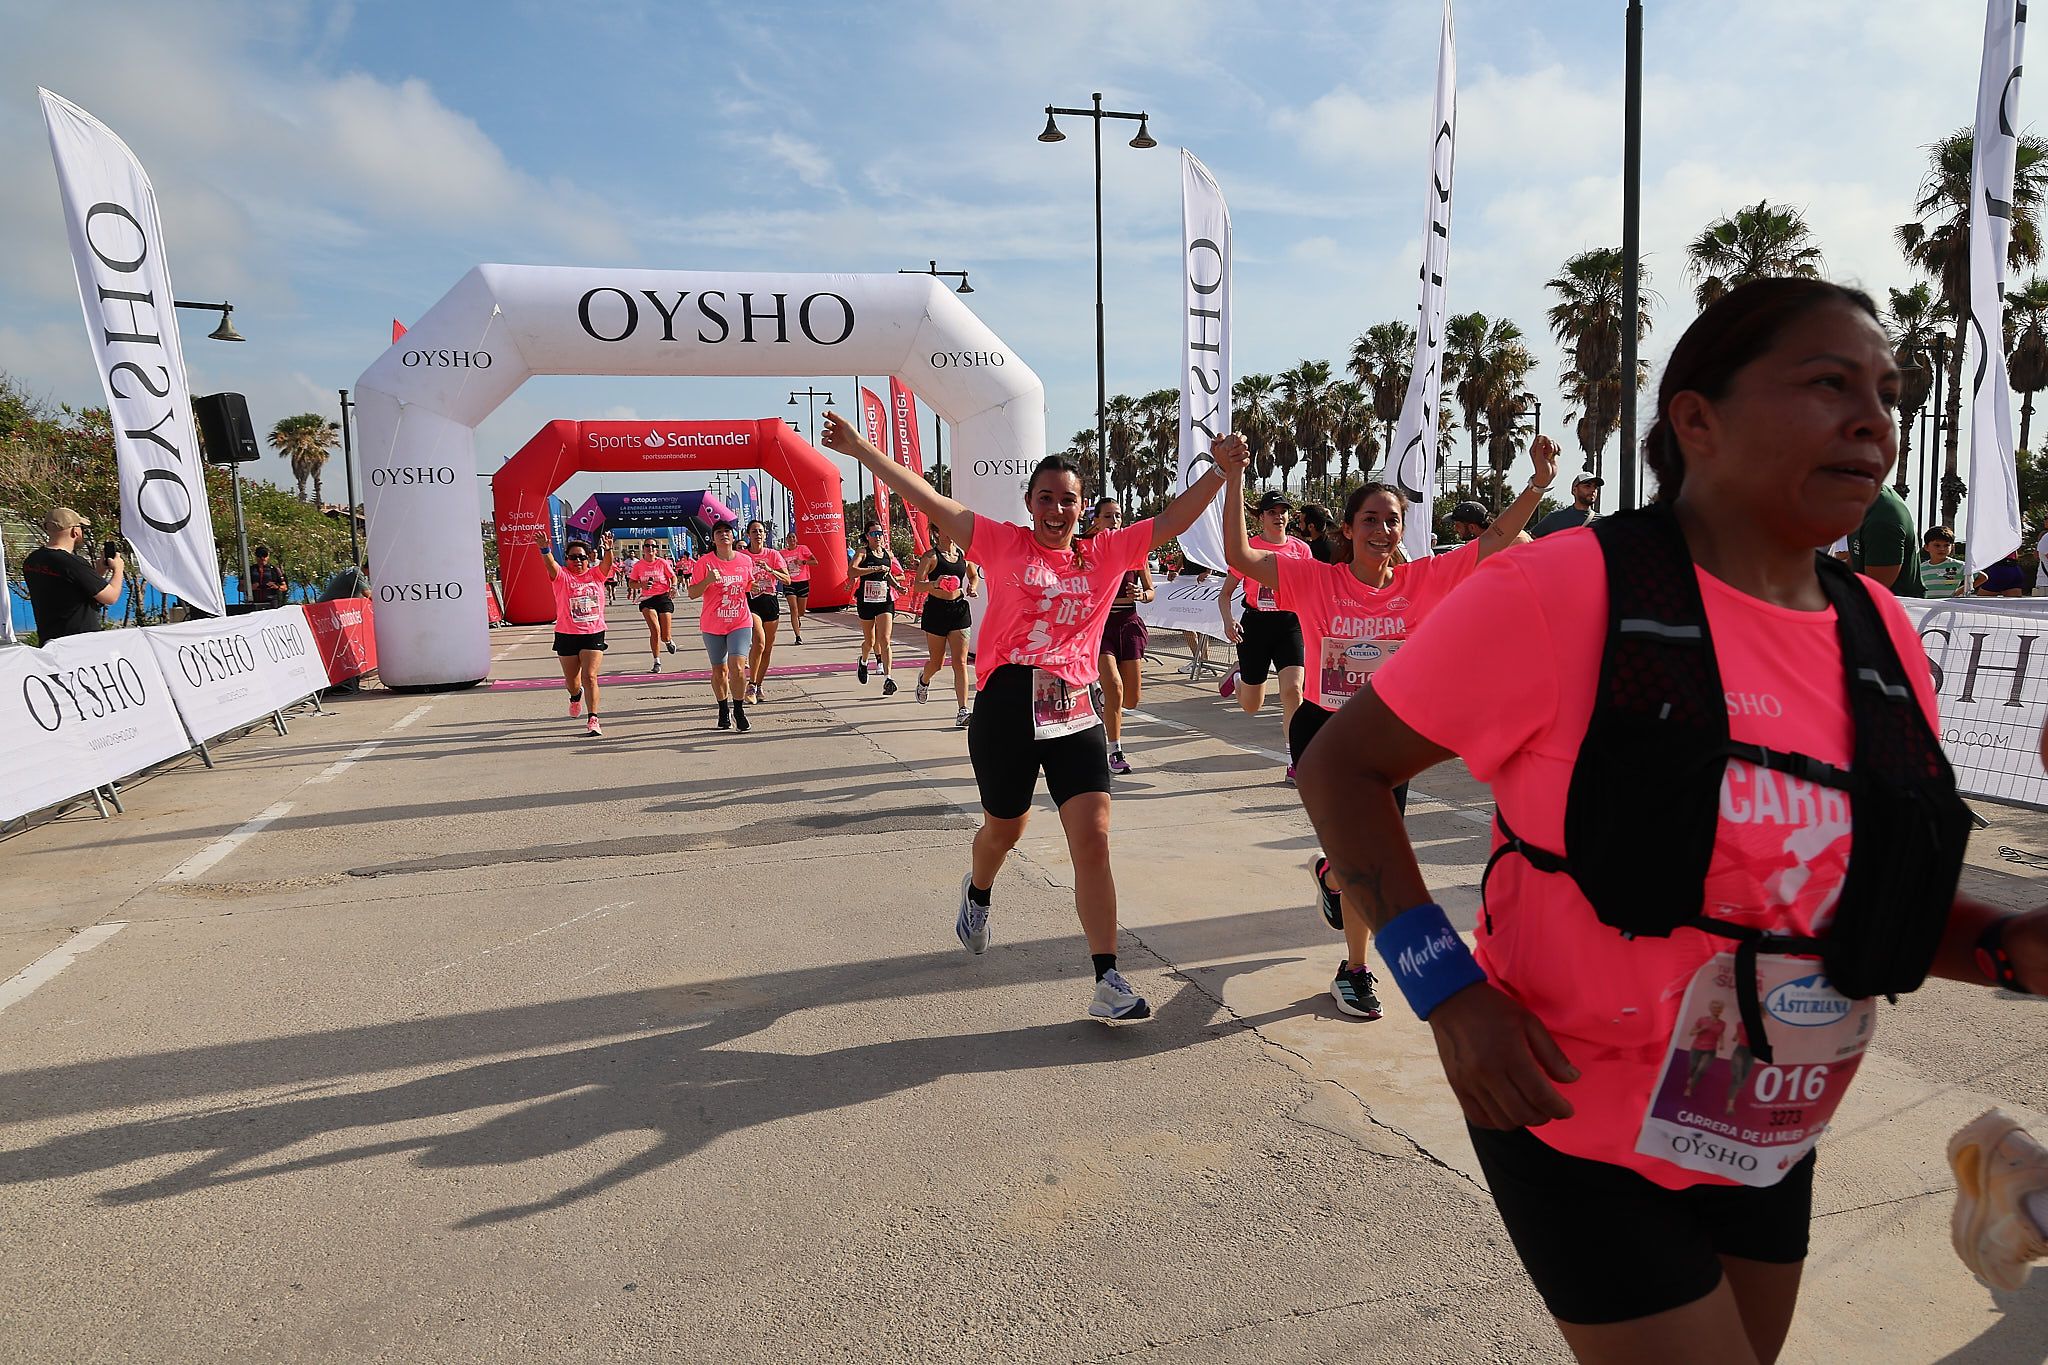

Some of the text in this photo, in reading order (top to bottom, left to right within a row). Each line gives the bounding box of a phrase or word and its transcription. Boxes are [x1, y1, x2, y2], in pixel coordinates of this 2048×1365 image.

[578, 287, 855, 345] OYSHO
[402, 350, 493, 369] OYSHO
[930, 351, 1004, 369] OYSHO
[588, 431, 750, 451] Sports Santander
[372, 466, 455, 486] OYSHO
[973, 459, 1039, 476] OYSHO
[811, 501, 833, 509] Sports
[509, 511, 534, 520] Sports
[507, 523, 545, 532] Santander
[380, 582, 463, 602] OYSHO
[717, 609, 739, 618] MUJER
[1331, 616, 1406, 637] CARRERA
[261, 622, 305, 664] OYSHO
[178, 634, 255, 688] OYSHO
[23, 657, 146, 732] OYSHO
[1055, 697, 1077, 711] 016
[1328, 697, 1347, 705] OYS
[1724, 692, 1782, 718] SHO
[1754, 1065, 1830, 1103] 016
[1677, 1110, 1738, 1137] CARRERA
[1741, 1130, 1759, 1143] DE
[1761, 1131, 1775, 1143] LA
[1769, 1109, 1803, 1127] 3273
[1672, 1135, 1758, 1172] OYSHO
